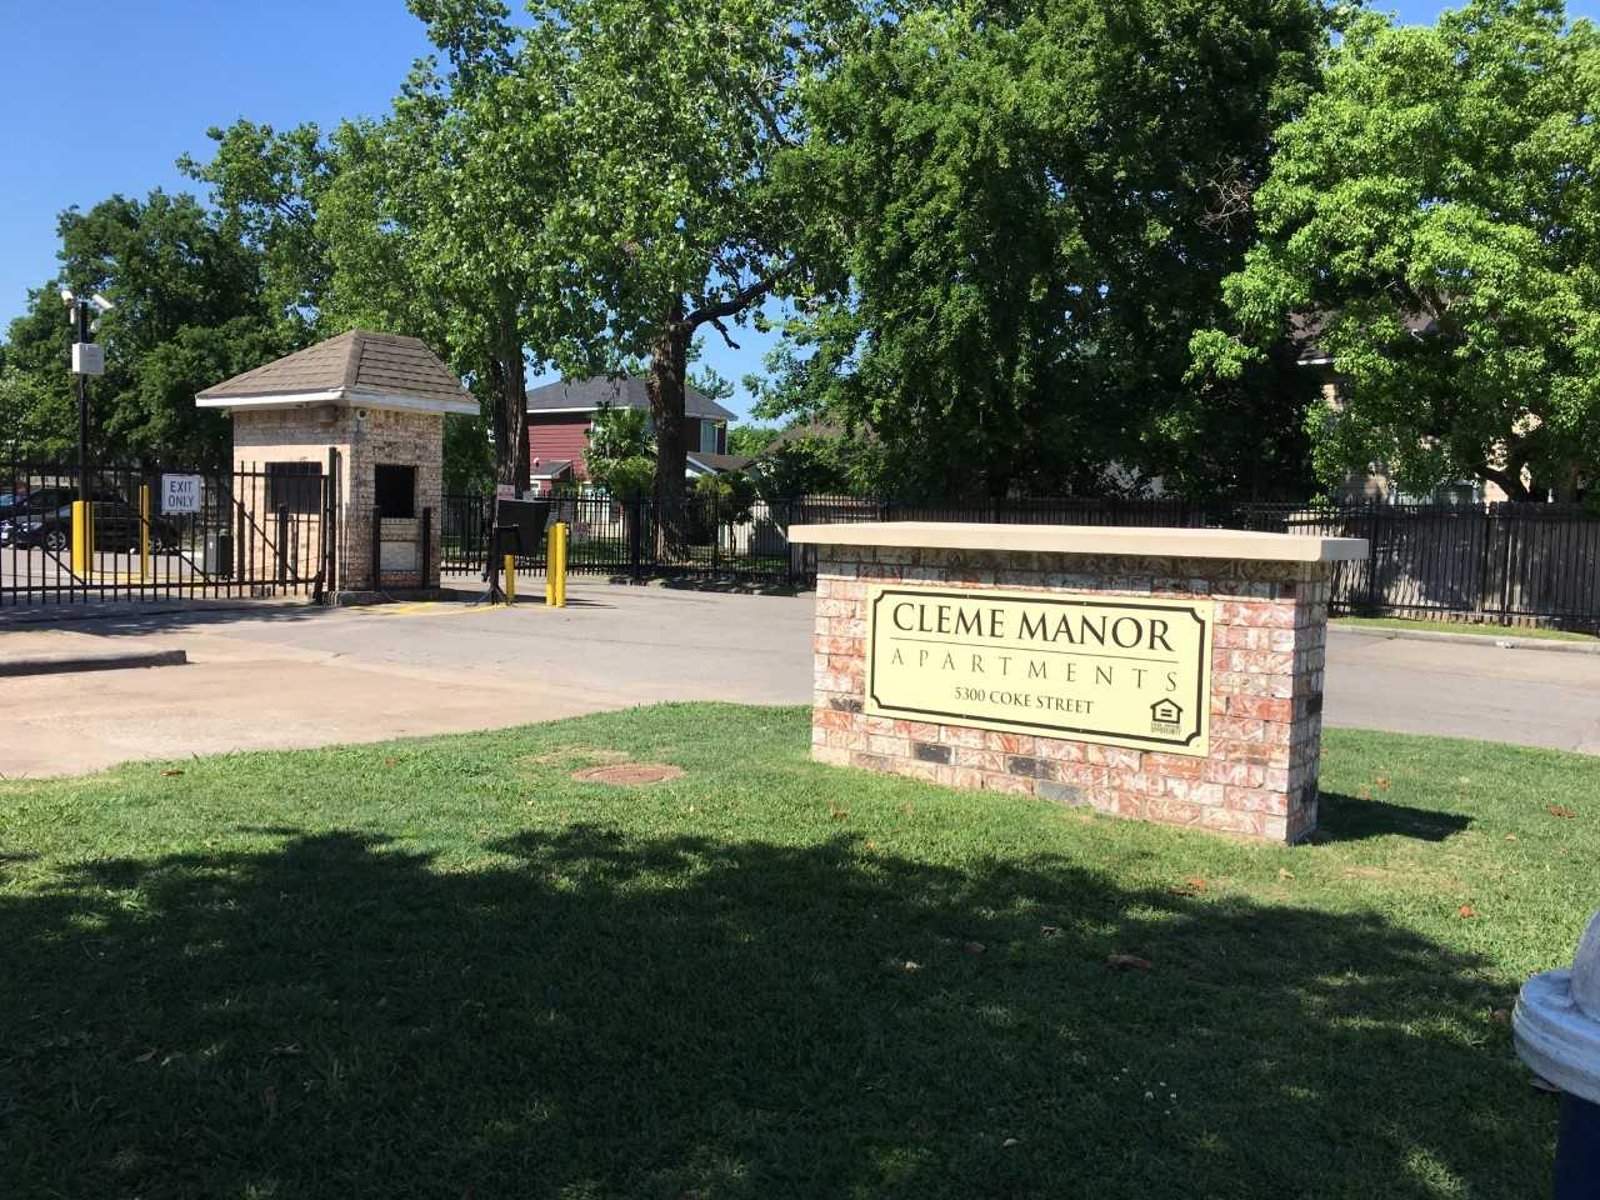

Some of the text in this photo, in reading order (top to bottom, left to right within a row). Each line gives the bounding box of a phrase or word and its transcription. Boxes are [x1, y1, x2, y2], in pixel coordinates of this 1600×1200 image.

[168, 494, 195, 507] ONLY
[170, 480, 192, 493] EXIT
[892, 602, 1177, 652] CLEME MANOR
[890, 647, 1178, 692] APARTMENTS
[954, 686, 1095, 715] 5300 COKE STREET
